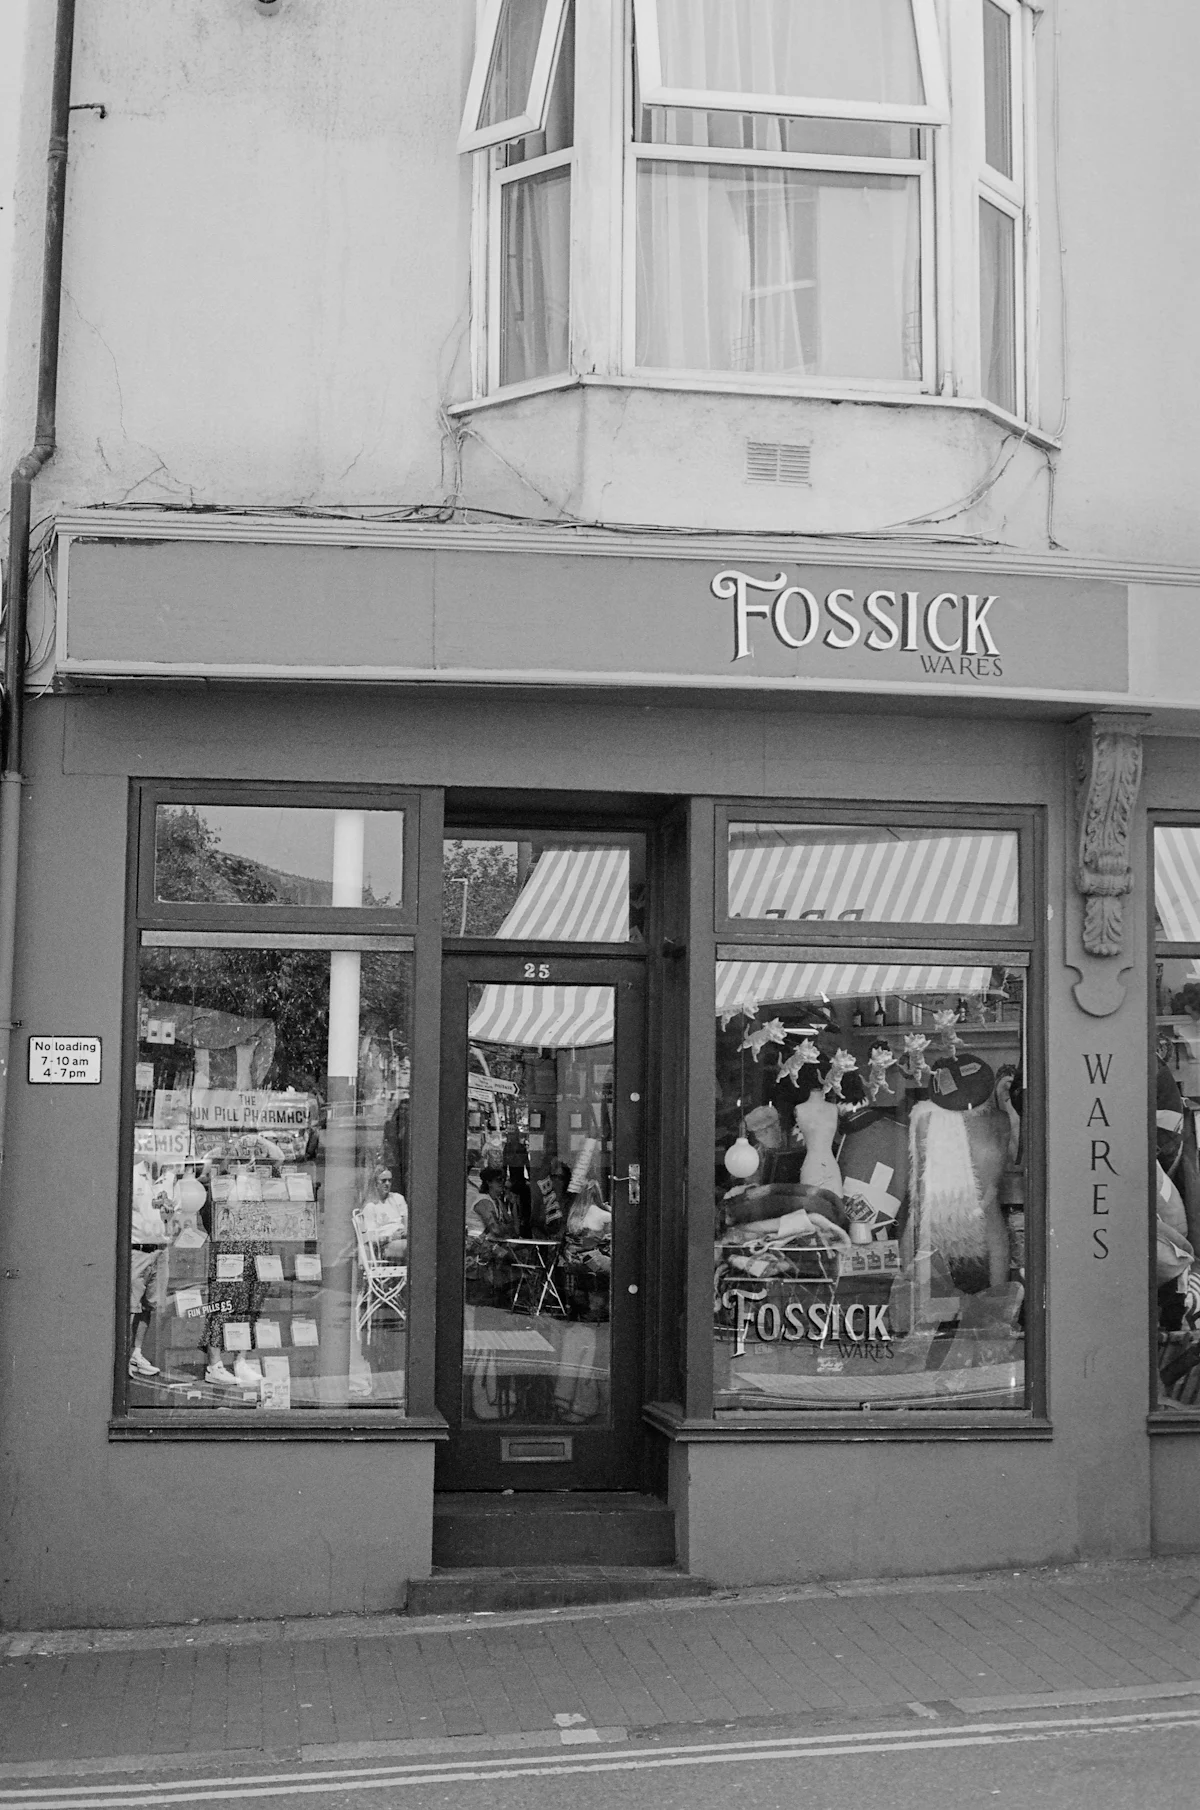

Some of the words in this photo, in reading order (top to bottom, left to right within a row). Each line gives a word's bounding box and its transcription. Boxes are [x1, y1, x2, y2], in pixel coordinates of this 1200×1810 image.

[710, 569, 1001, 662] FOSSICK
[920, 655, 1004, 680] WARES
[524, 962, 550, 979] 25
[35, 1042, 51, 1051] No
[55, 1042, 96, 1053] loading
[239, 1094, 256, 1106] THE
[191, 1106, 209, 1121] UN
[215, 1106, 240, 1122] PILL
[244, 1108, 311, 1124] PHARMACY
[1081, 1053, 1121, 1260] WARES
[187, 1308, 201, 1318] FUN
[202, 1302, 221, 1314] PILLS
[220, 1300, 233, 1313] £5
[722, 1288, 892, 1359] FOSSICK
[838, 1343, 895, 1363] WARES
